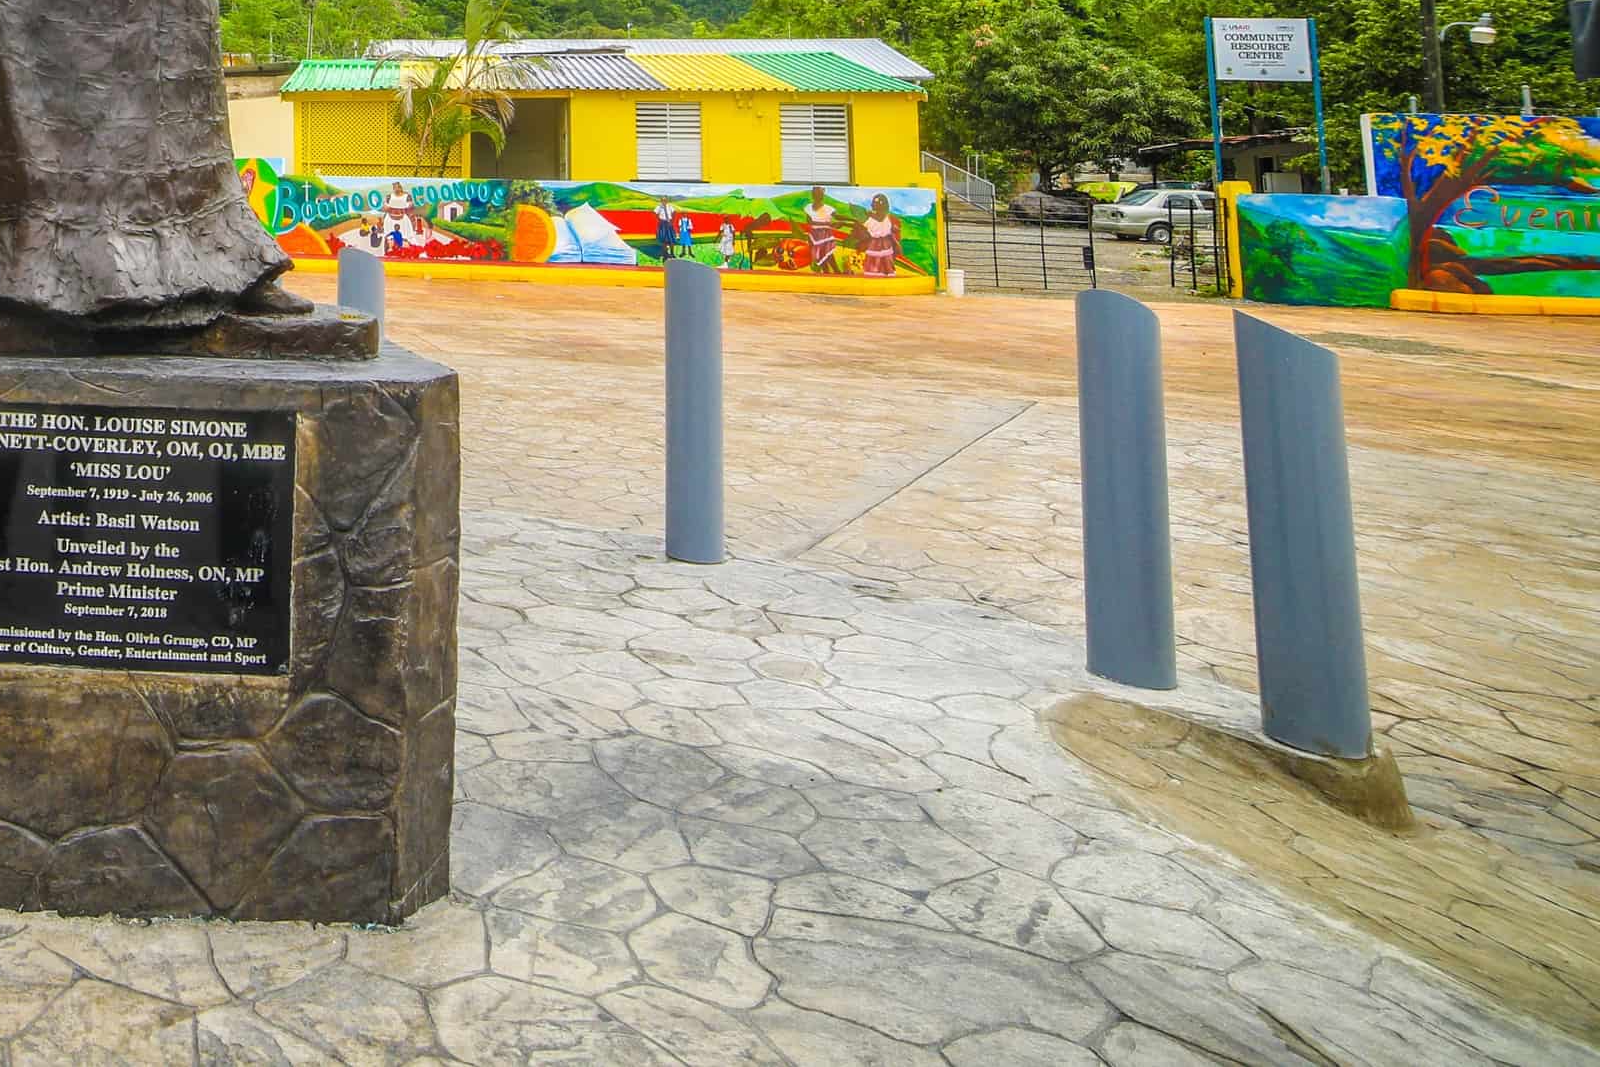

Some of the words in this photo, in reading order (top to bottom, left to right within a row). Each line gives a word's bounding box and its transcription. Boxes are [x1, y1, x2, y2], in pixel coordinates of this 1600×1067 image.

[1224, 33, 1294, 42] COMMUNITY
[1230, 42, 1290, 51] RESOURCE
[1238, 51, 1284, 60] CENTRE
[41, 414, 90, 432] HON.
[94, 416, 166, 435] LOUISE
[170, 420, 248, 438] SIMONE
[166, 440, 204, 461] OM,
[208, 442, 239, 462] OJ,
[242, 444, 286, 461] MBE
[26, 484, 87, 500] September
[89, 487, 100, 501] 7,
[103, 487, 129, 501] 1919
[139, 489, 164, 503] July
[166, 490, 184, 504] 26,
[186, 492, 213, 503] 2006
[37, 510, 91, 527] Artist:
[95, 512, 136, 529] Basil
[140, 515, 201, 532] Watson
[56, 538, 126, 555] Unveiled
[130, 542, 150, 560] by
[154, 543, 180, 558] the
[15, 557, 54, 573] Hon.
[58, 559, 123, 576] Andrew
[126, 563, 195, 582] Holness,
[198, 565, 231, 584] ON,
[234, 567, 265, 583] MP
[56, 581, 105, 598] Prime
[108, 584, 178, 601] Minister
[64, 603, 125, 617] September
[127, 606, 138, 619] 7,
[140, 607, 168, 619] 2018
[57, 628, 73, 642] by
[74, 630, 93, 641] the
[95, 630, 123, 643] Hon.
[125, 632, 160, 644] Olivia
[163, 634, 209, 648] Grange,
[211, 636, 234, 650] CD,
[236, 637, 258, 648] MP
[13, 641, 26, 653] of
[28, 642, 76, 657] Culture,
[78, 645, 123, 660] Gender,
[125, 647, 209, 662] Entertainment
[210, 652, 232, 663] and
[234, 652, 267, 666] Sport
